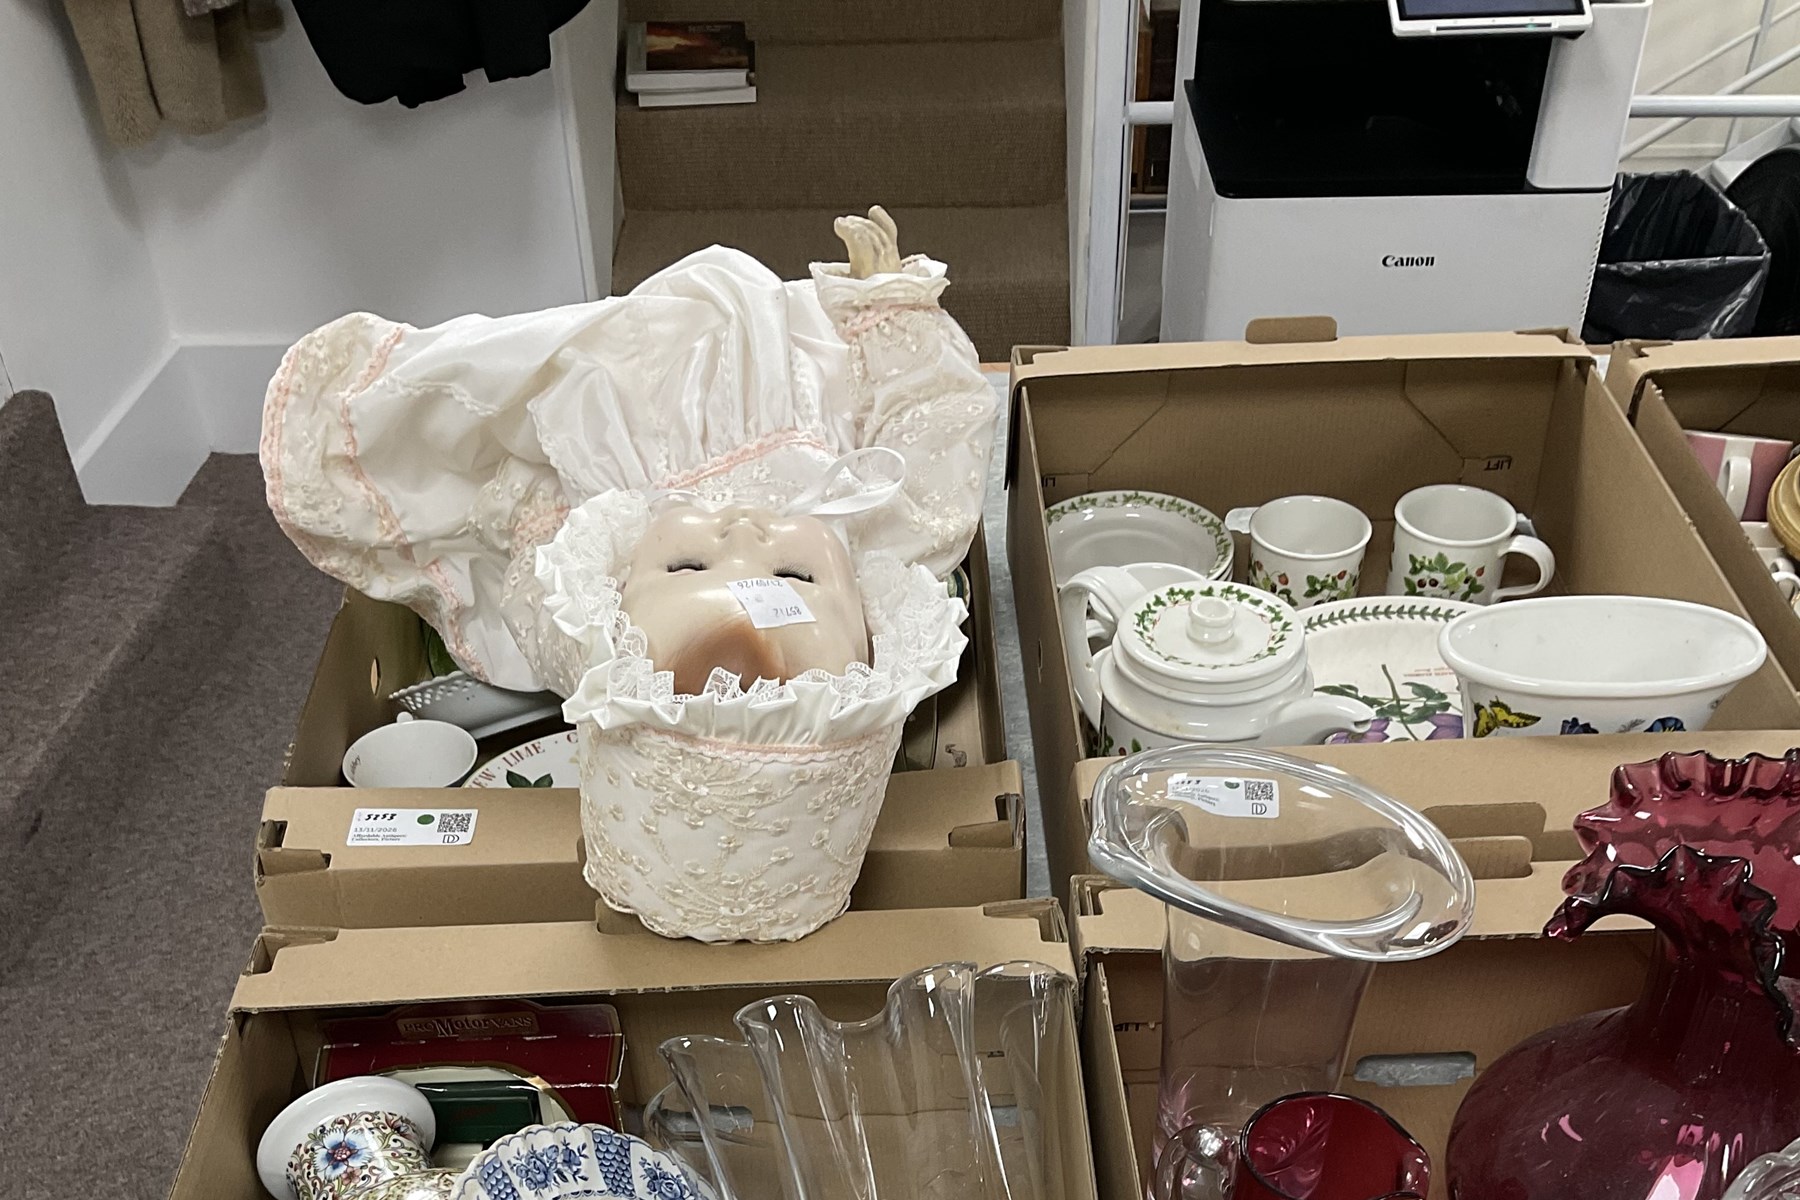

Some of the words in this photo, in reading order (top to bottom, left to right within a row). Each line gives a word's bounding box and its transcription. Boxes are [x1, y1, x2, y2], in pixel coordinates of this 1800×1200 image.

[1381, 254, 1435, 268] Canon
[1484, 458, 1513, 471] LIFT
[469, 767, 497, 789] EW
[502, 741, 546, 768] LIME
